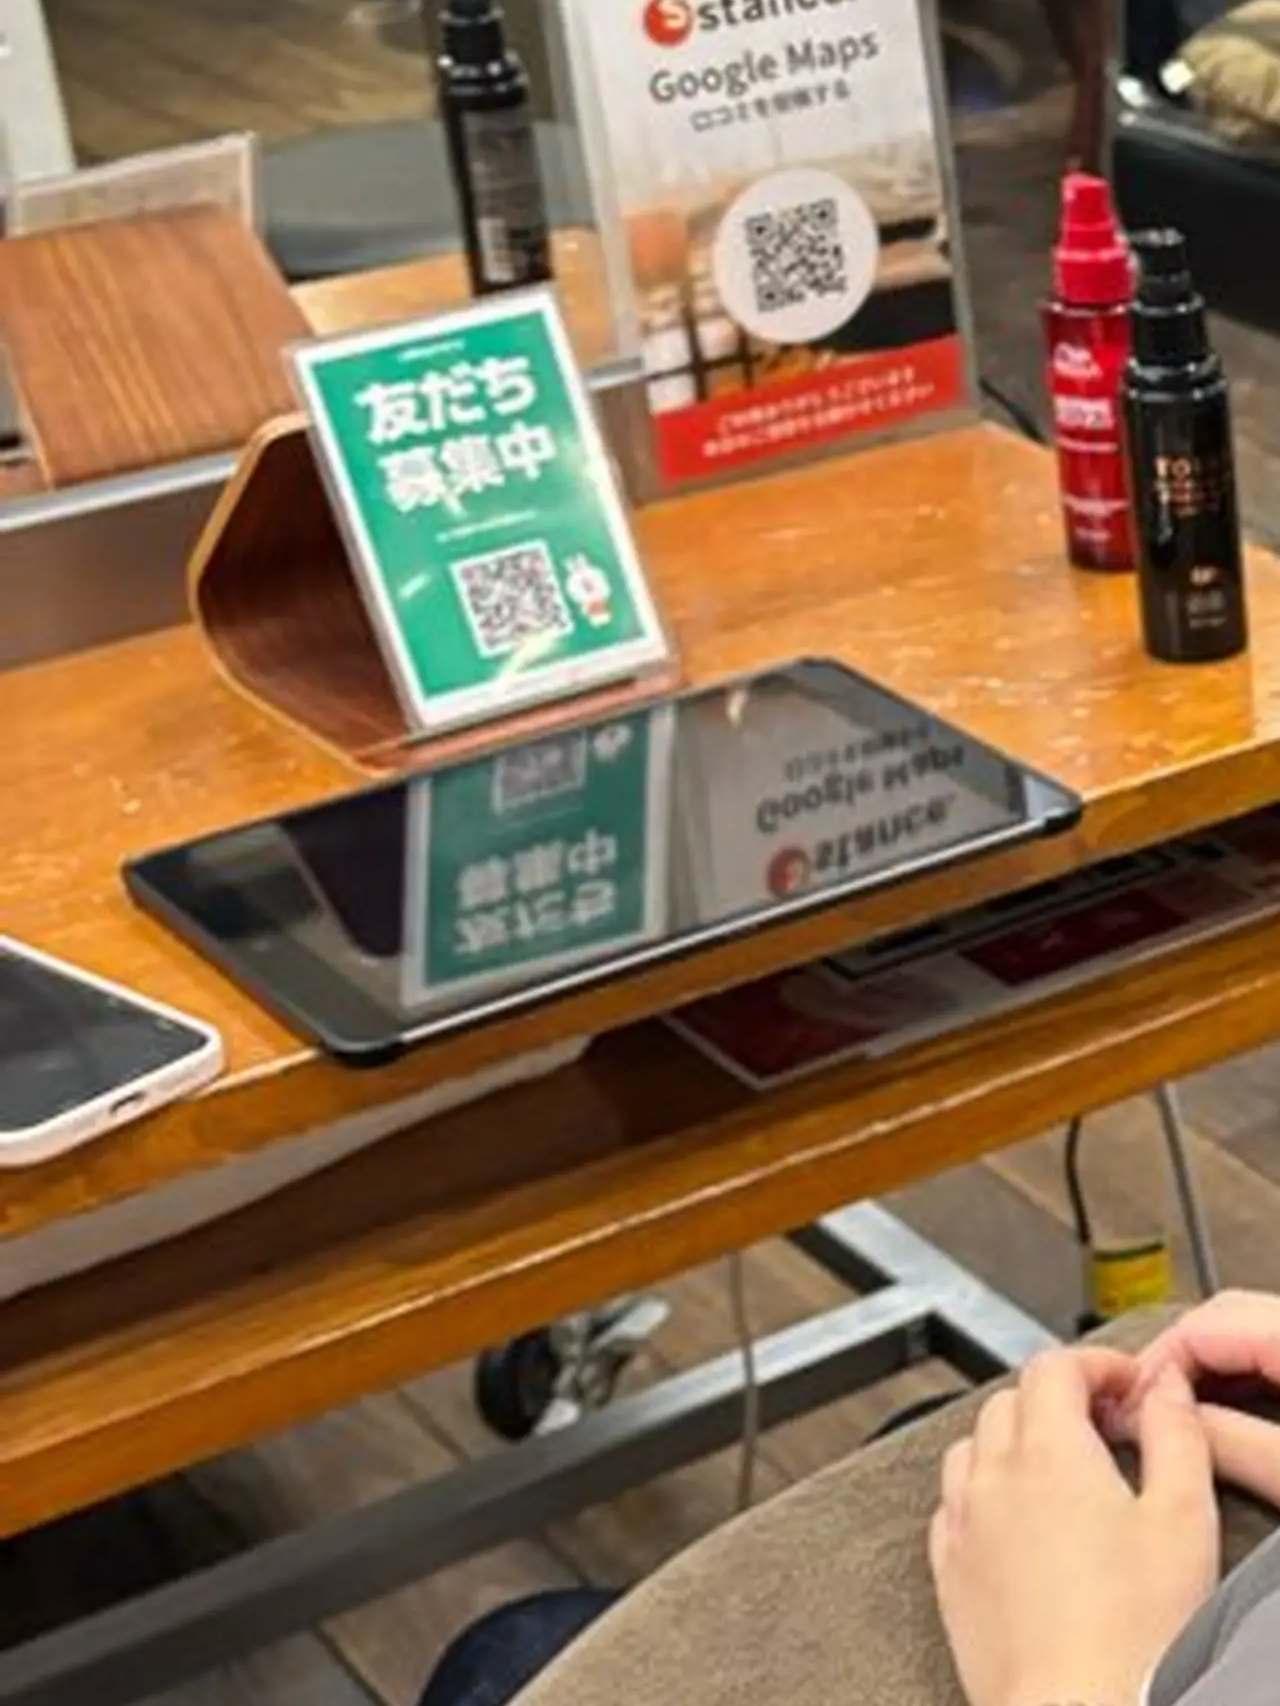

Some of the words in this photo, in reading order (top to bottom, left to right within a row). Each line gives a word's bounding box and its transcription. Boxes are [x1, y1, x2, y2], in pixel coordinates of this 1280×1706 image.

[648, 50, 780, 104] Google
[785, 32, 880, 75] Maps
[354, 355, 537, 444] 友だち
[377, 422, 557, 516] 募集中
